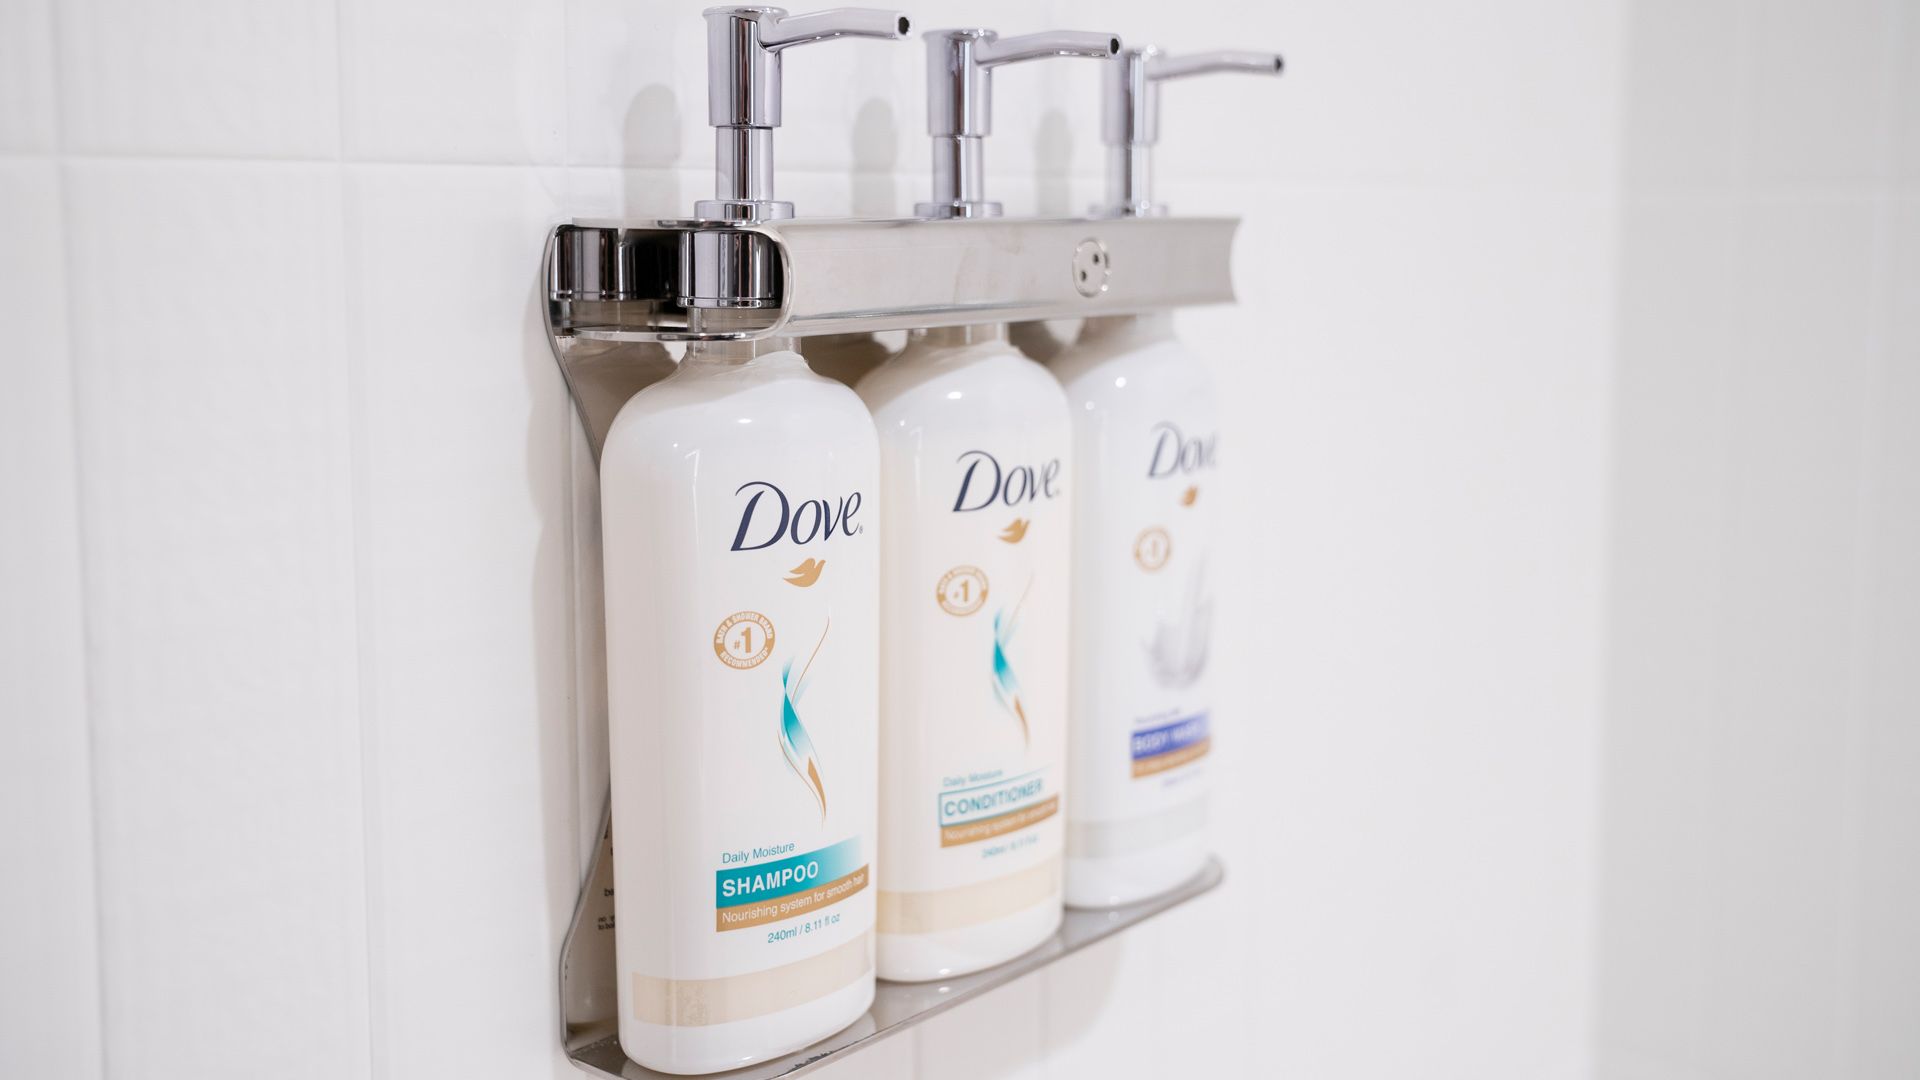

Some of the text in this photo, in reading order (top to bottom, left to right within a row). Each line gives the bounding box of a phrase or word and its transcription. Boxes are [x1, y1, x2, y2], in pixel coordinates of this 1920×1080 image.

[952, 450, 1060, 512] Dove
[730, 481, 862, 551] Dove
[733, 626, 752, 653] #1
[944, 778, 1043, 817] CONDITIONER
[722, 842, 795, 863] Daily Moisture
[722, 861, 819, 897] SHAMPOO
[722, 904, 778, 923] Nourishing
[780, 895, 812, 913] system
[813, 891, 825, 903] for
[826, 880, 853, 898] smooth
[767, 927, 797, 943] 240ml
[805, 920, 822, 933] 8.11
[830, 913, 841, 922] oz
